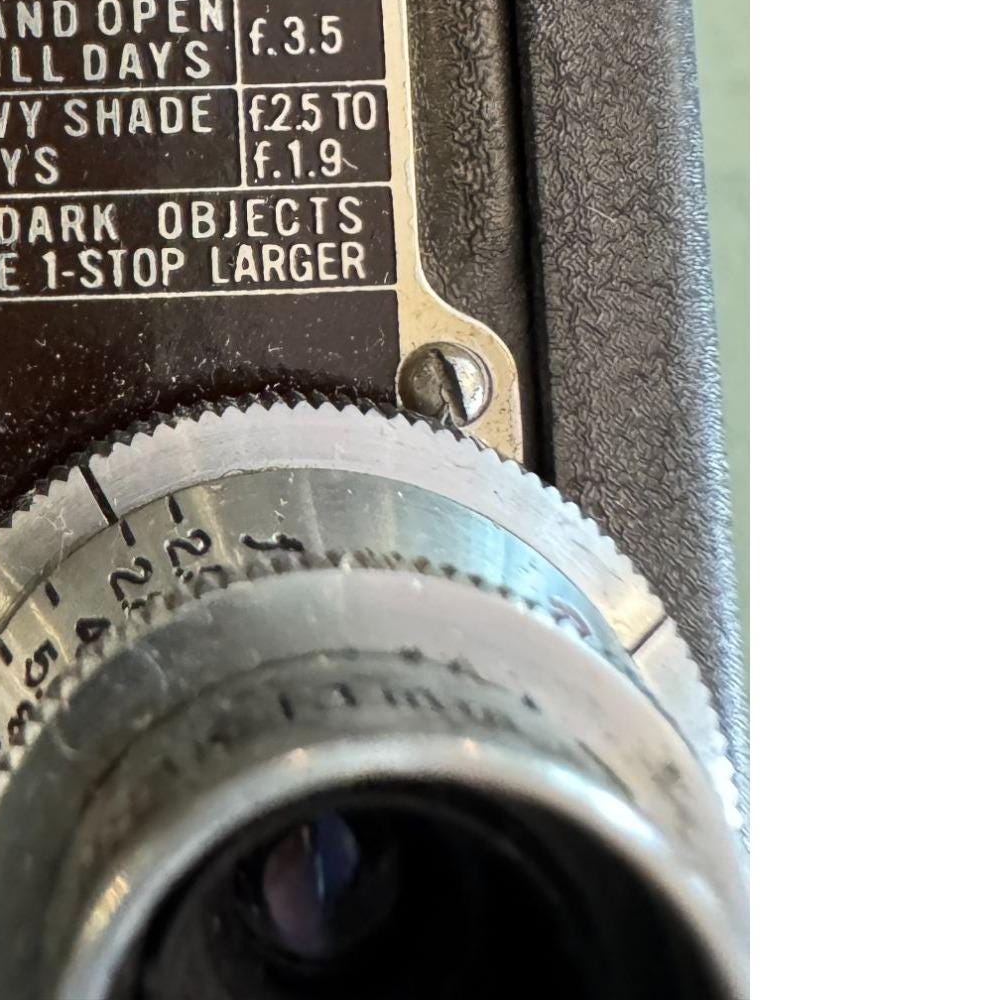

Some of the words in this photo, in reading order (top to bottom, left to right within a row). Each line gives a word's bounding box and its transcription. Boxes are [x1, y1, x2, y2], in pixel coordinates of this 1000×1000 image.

[249, 16, 343, 56] f.3.5
[83, 36, 212, 81] DAYS
[64, 93, 213, 137] SHADE
[332, 91, 379, 130] TO
[255, 139, 339, 179] f.1.9
[158, 195, 363, 241] OBJECTS
[45, 248, 186, 289] 1-STOP
[211, 241, 366, 286] LARGER
